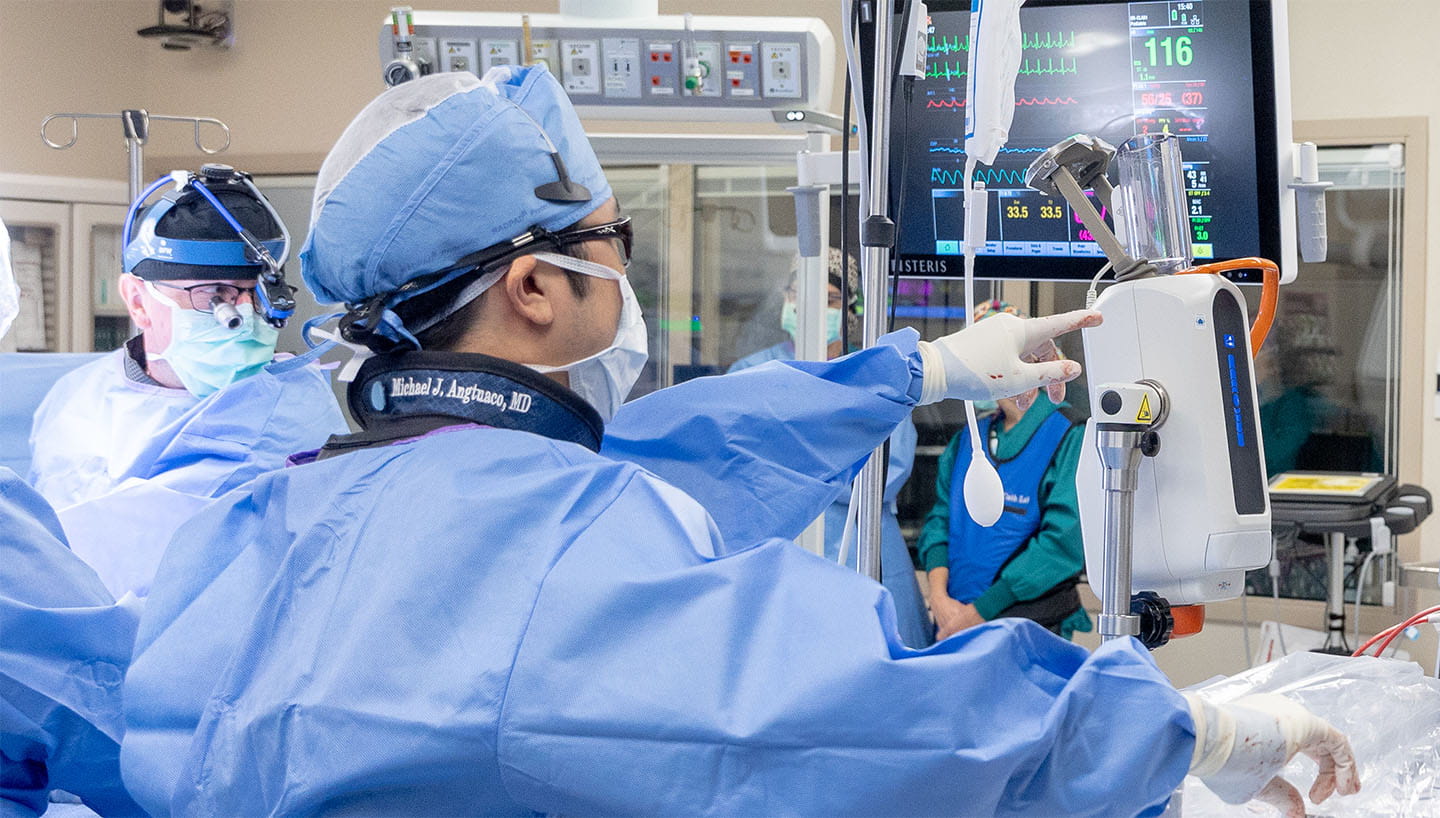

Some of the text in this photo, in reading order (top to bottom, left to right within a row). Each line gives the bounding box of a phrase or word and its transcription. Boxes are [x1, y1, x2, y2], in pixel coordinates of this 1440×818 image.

[1144, 36, 1193, 67] 116
[1181, 91, 1203, 105] (37)
[1187, 170, 1197, 179] 43
[1007, 206, 1029, 219] 33.5
[1040, 206, 1062, 219] 33.5
[1191, 206, 1202, 215] 2.1
[1196, 231, 1208, 240] 3.0
[905, 259, 947, 273] STERIS
[391, 377, 532, 413] Michael J. Angtuaco, MD
